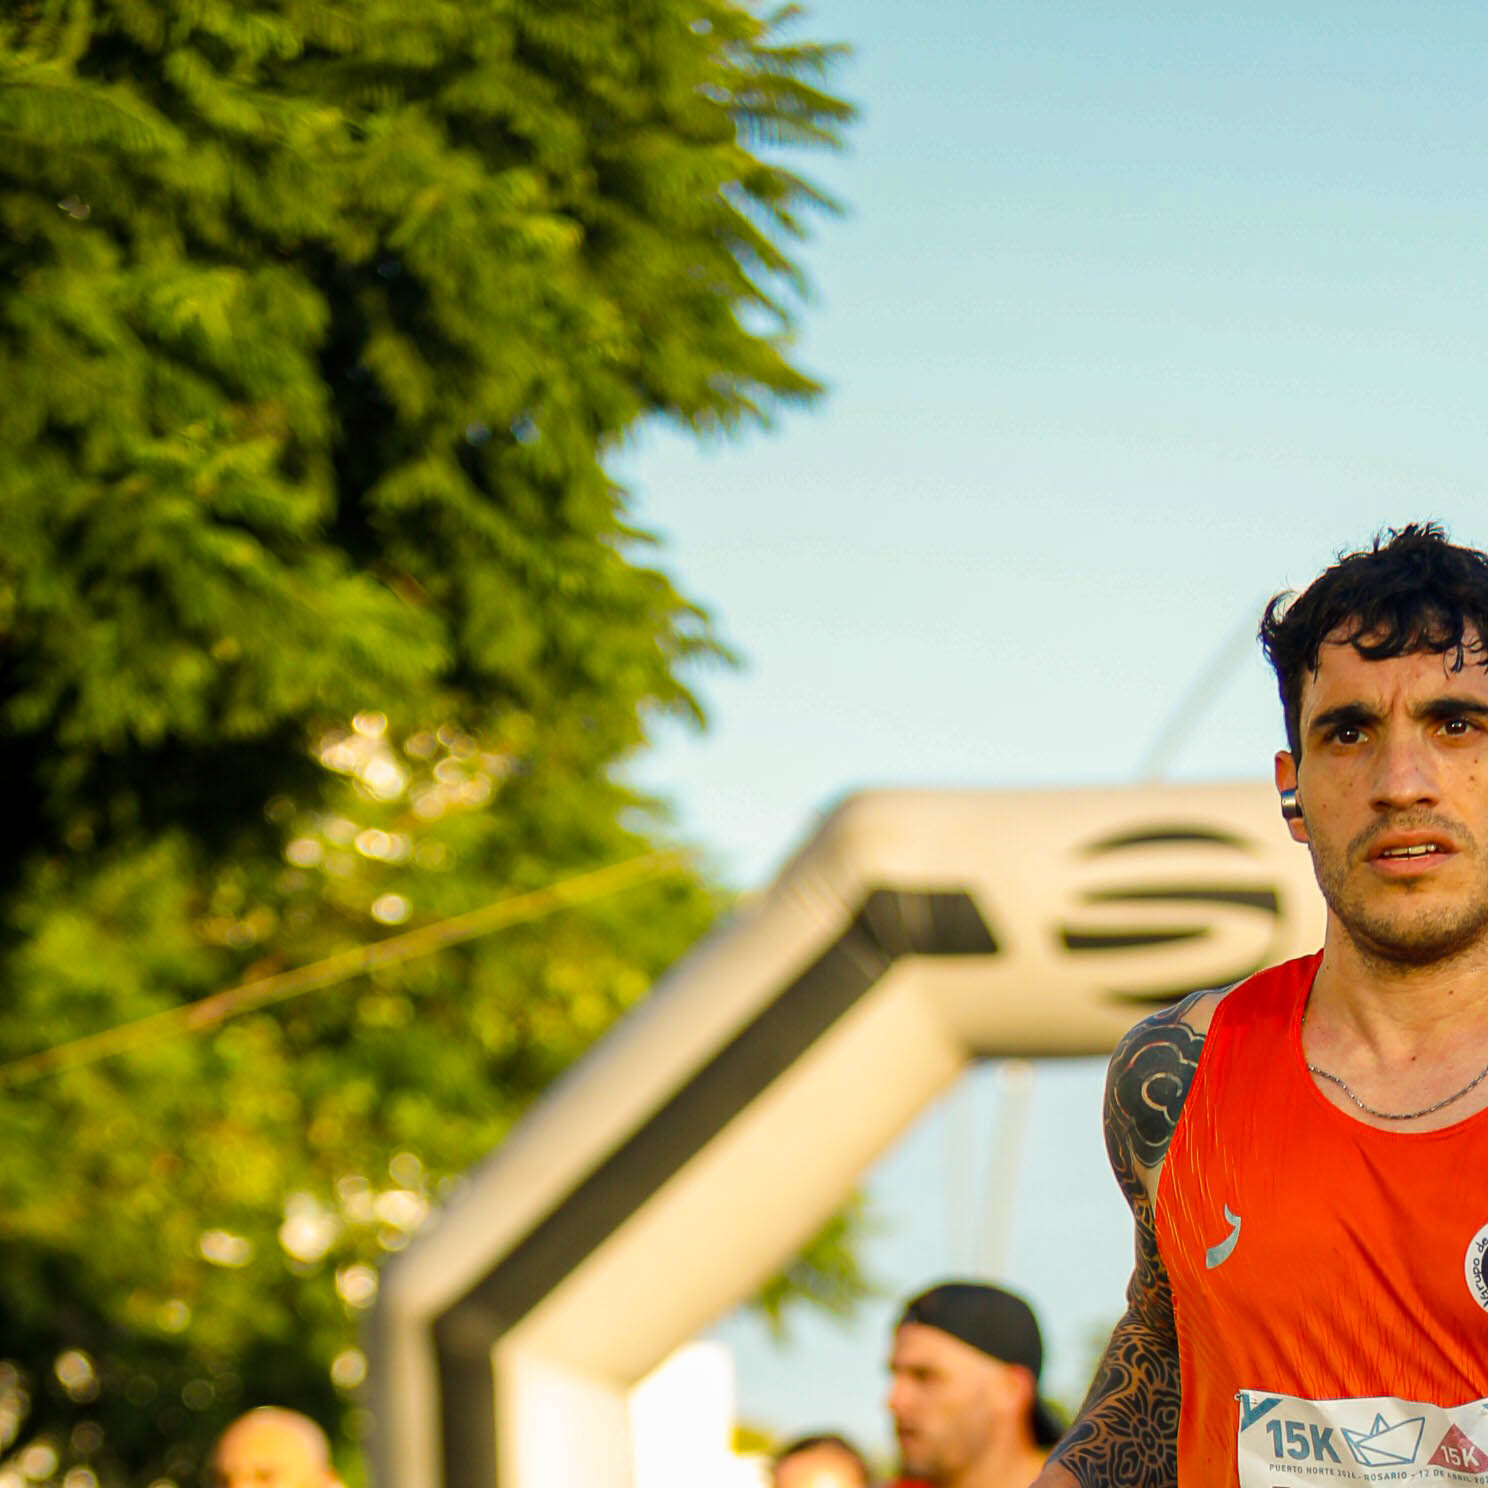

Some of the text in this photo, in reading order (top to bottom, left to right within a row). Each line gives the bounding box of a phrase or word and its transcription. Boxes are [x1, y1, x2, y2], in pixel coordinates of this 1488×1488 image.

[1475, 1238, 1488, 1253] de
[1265, 1418, 1341, 1463] 15K
[1440, 1445, 1480, 1468] 15K
[1269, 1463, 1303, 1474] PUERTO
[1306, 1466, 1334, 1476] NORTE
[1364, 1471, 1408, 1481] ROSARIO
[1419, 1470, 1429, 1478] 12
[1433, 1469, 1444, 1477] DE
[1448, 1472, 1472, 1482] ABRIL
